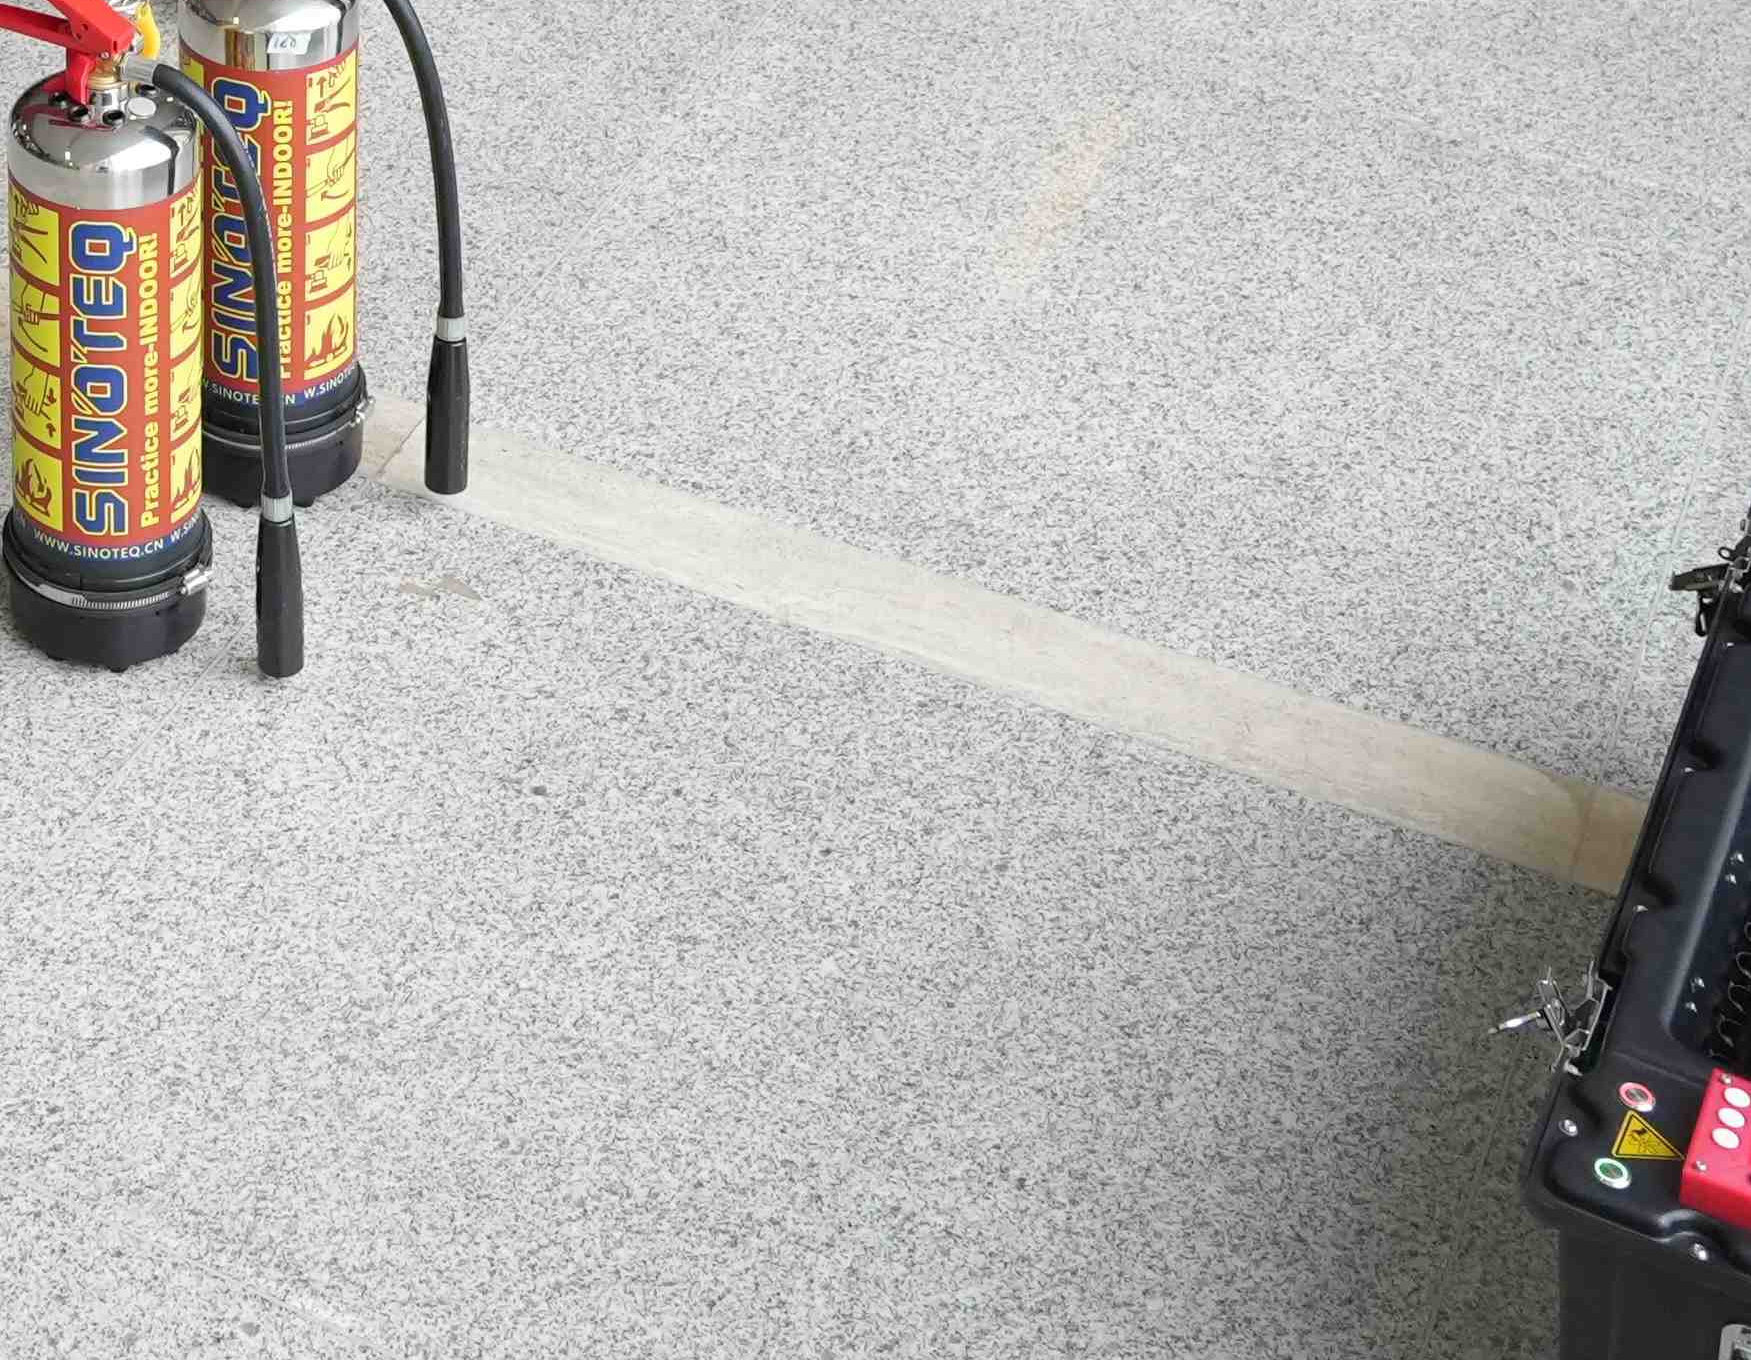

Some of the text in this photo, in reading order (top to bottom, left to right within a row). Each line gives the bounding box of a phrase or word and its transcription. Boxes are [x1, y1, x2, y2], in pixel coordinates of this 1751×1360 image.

[273, 100, 293, 274] more-INDOOR!
[70, 219, 139, 538] SINOTEQ
[138, 232, 160, 529] Practice more-INDOOR!
[33, 527, 164, 560] WWW.SINOTEQ.CN
